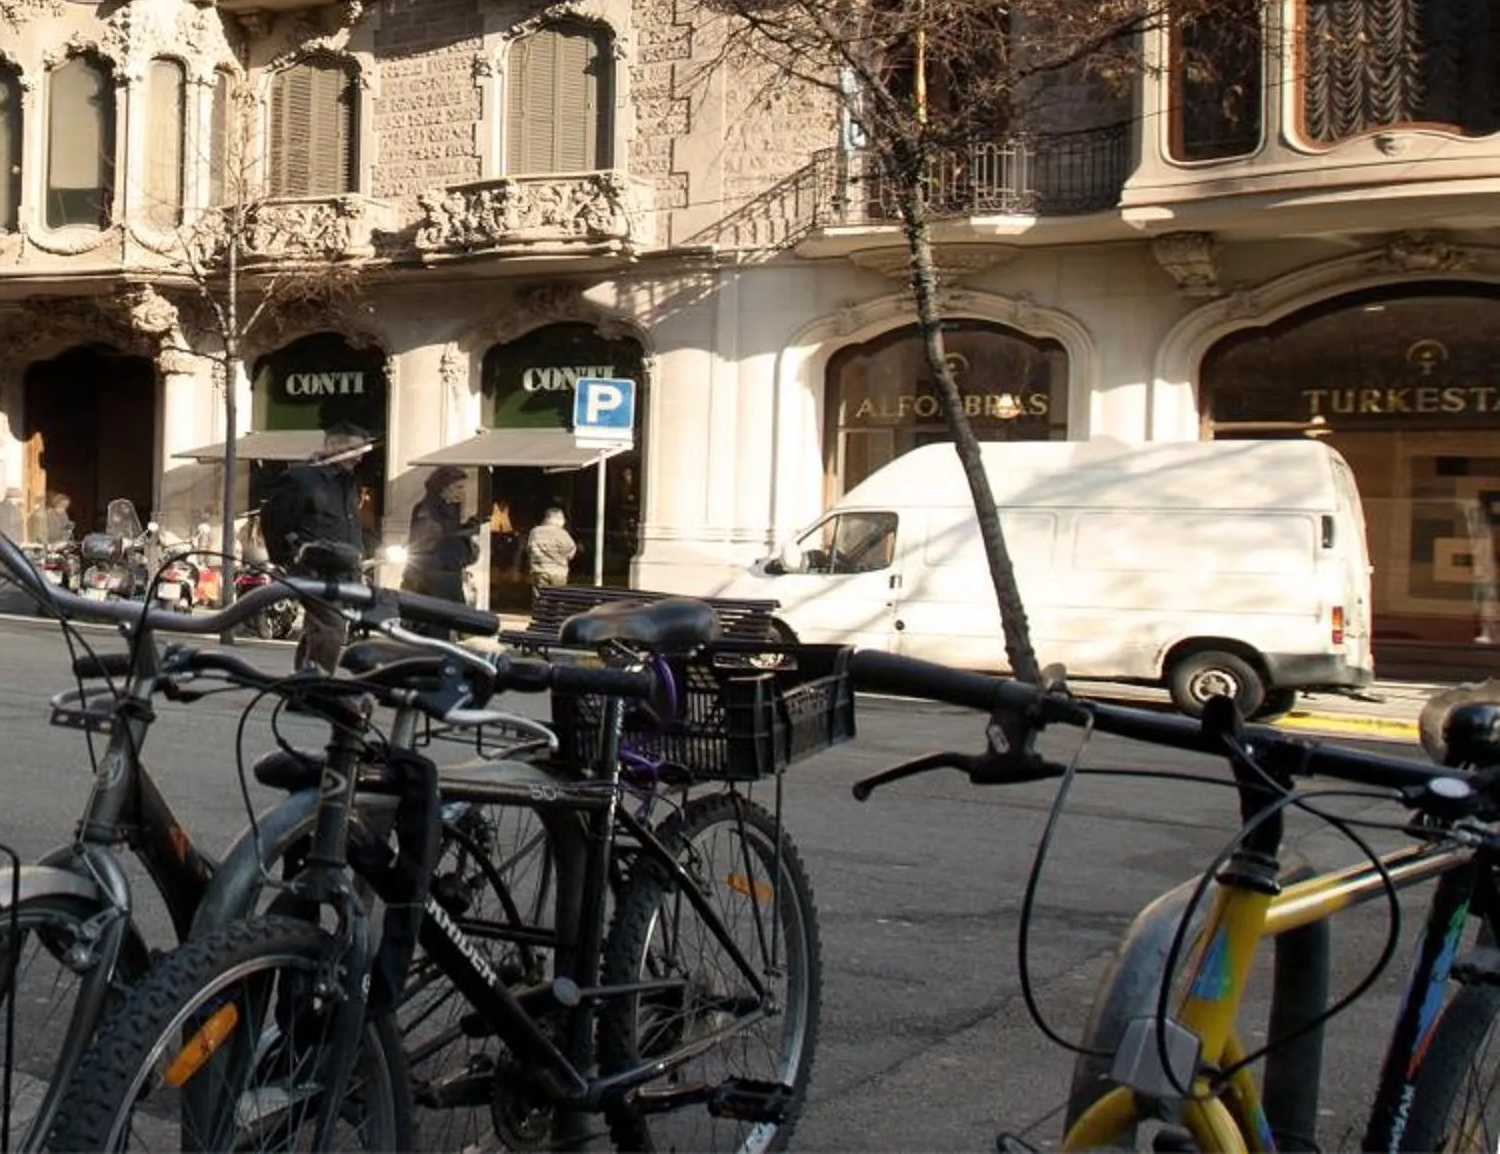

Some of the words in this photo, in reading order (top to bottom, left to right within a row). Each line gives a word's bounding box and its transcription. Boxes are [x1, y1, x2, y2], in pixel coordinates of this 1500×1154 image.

[285, 371, 364, 395] CONTI
[586, 383, 623, 423] P
[855, 393, 1048, 418] ALFOBRAS
